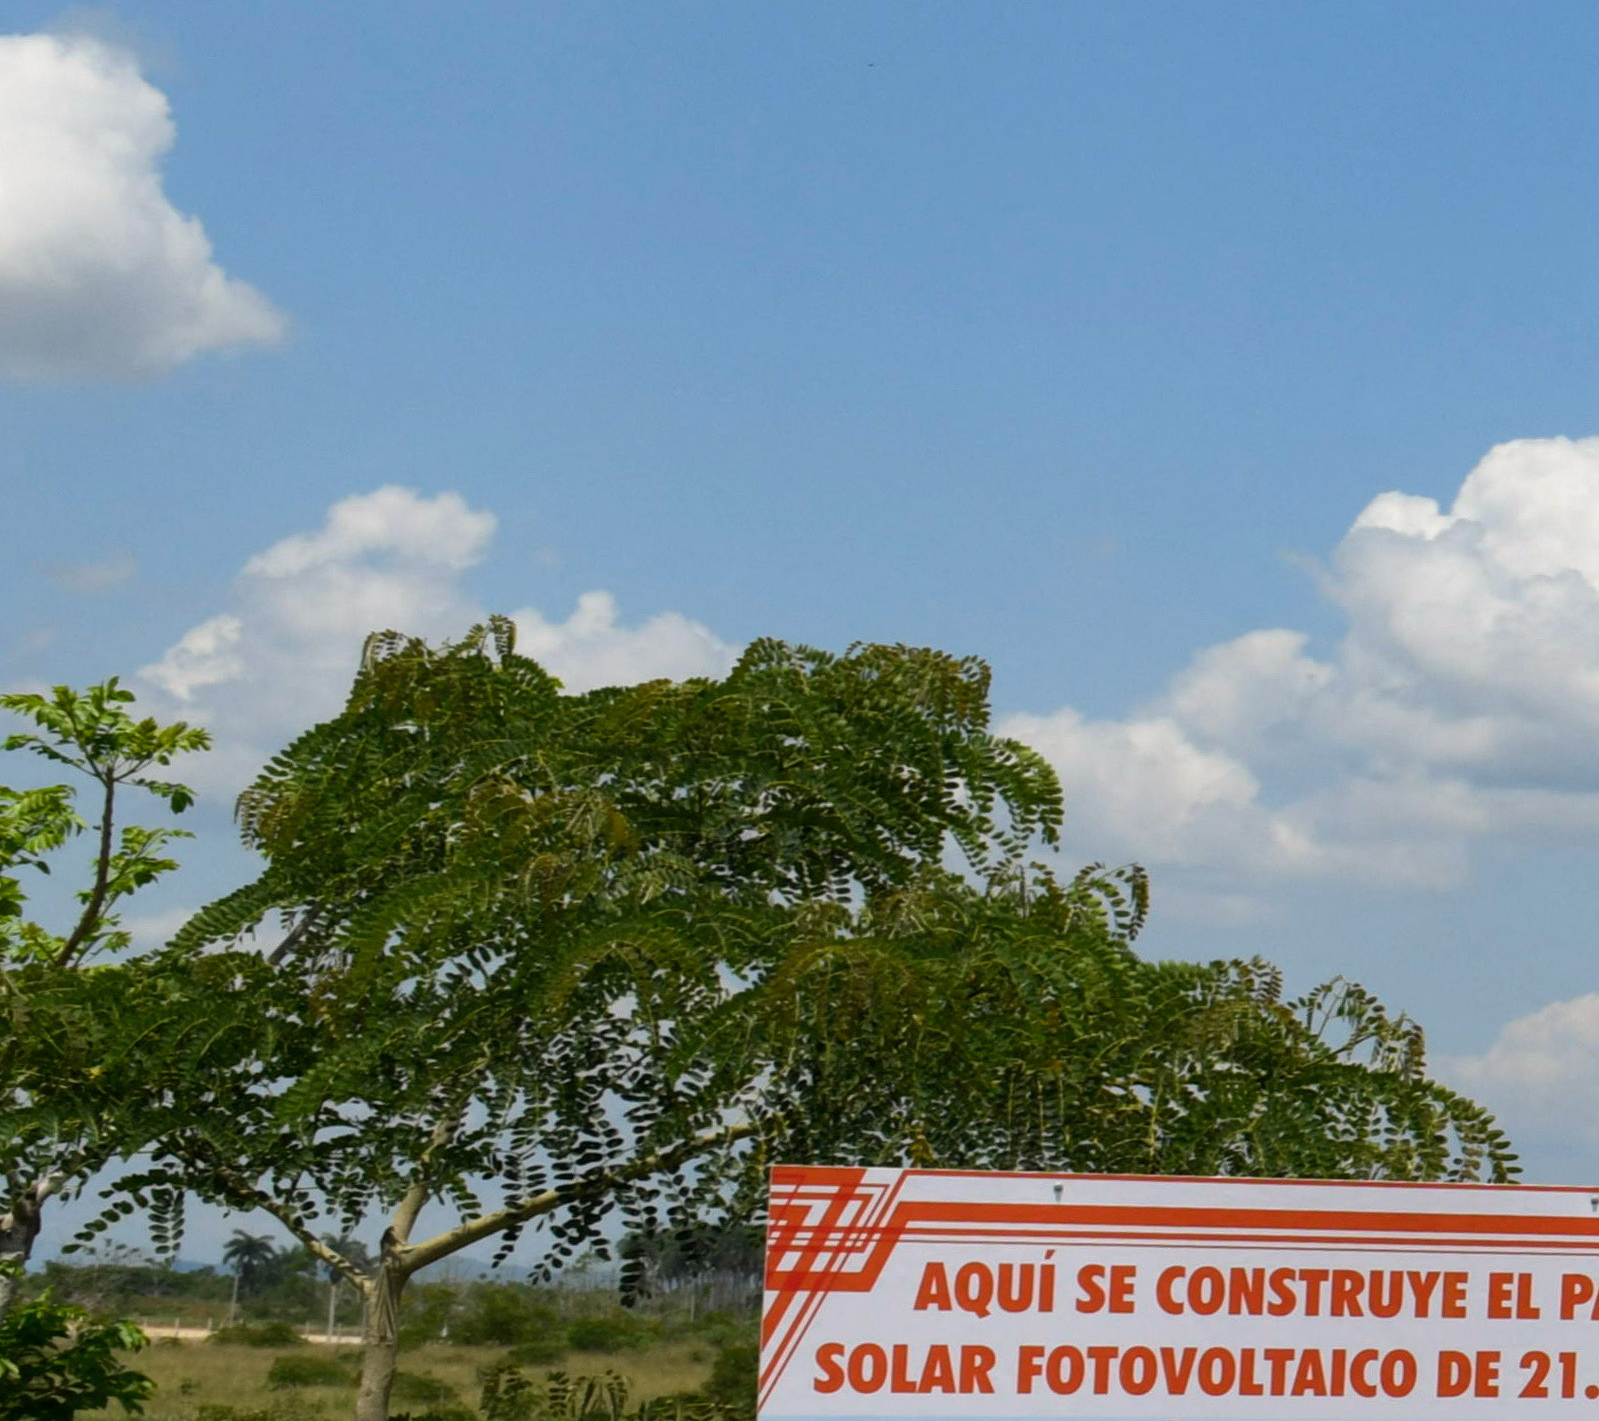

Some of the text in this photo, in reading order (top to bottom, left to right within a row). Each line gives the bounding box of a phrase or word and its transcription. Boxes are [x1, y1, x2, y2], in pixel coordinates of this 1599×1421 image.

[913, 1249, 1056, 1318] AQUÍ
[1075, 1263, 1137, 1314] SE
[1156, 1264, 1469, 1320] CONSTRUYE
[1487, 1272, 1541, 1320] EL
[814, 1342, 997, 1395] SOLAR
[1016, 1345, 1418, 1398] FOTOVOLTAICO
[1437, 1350, 1501, 1398] DE
